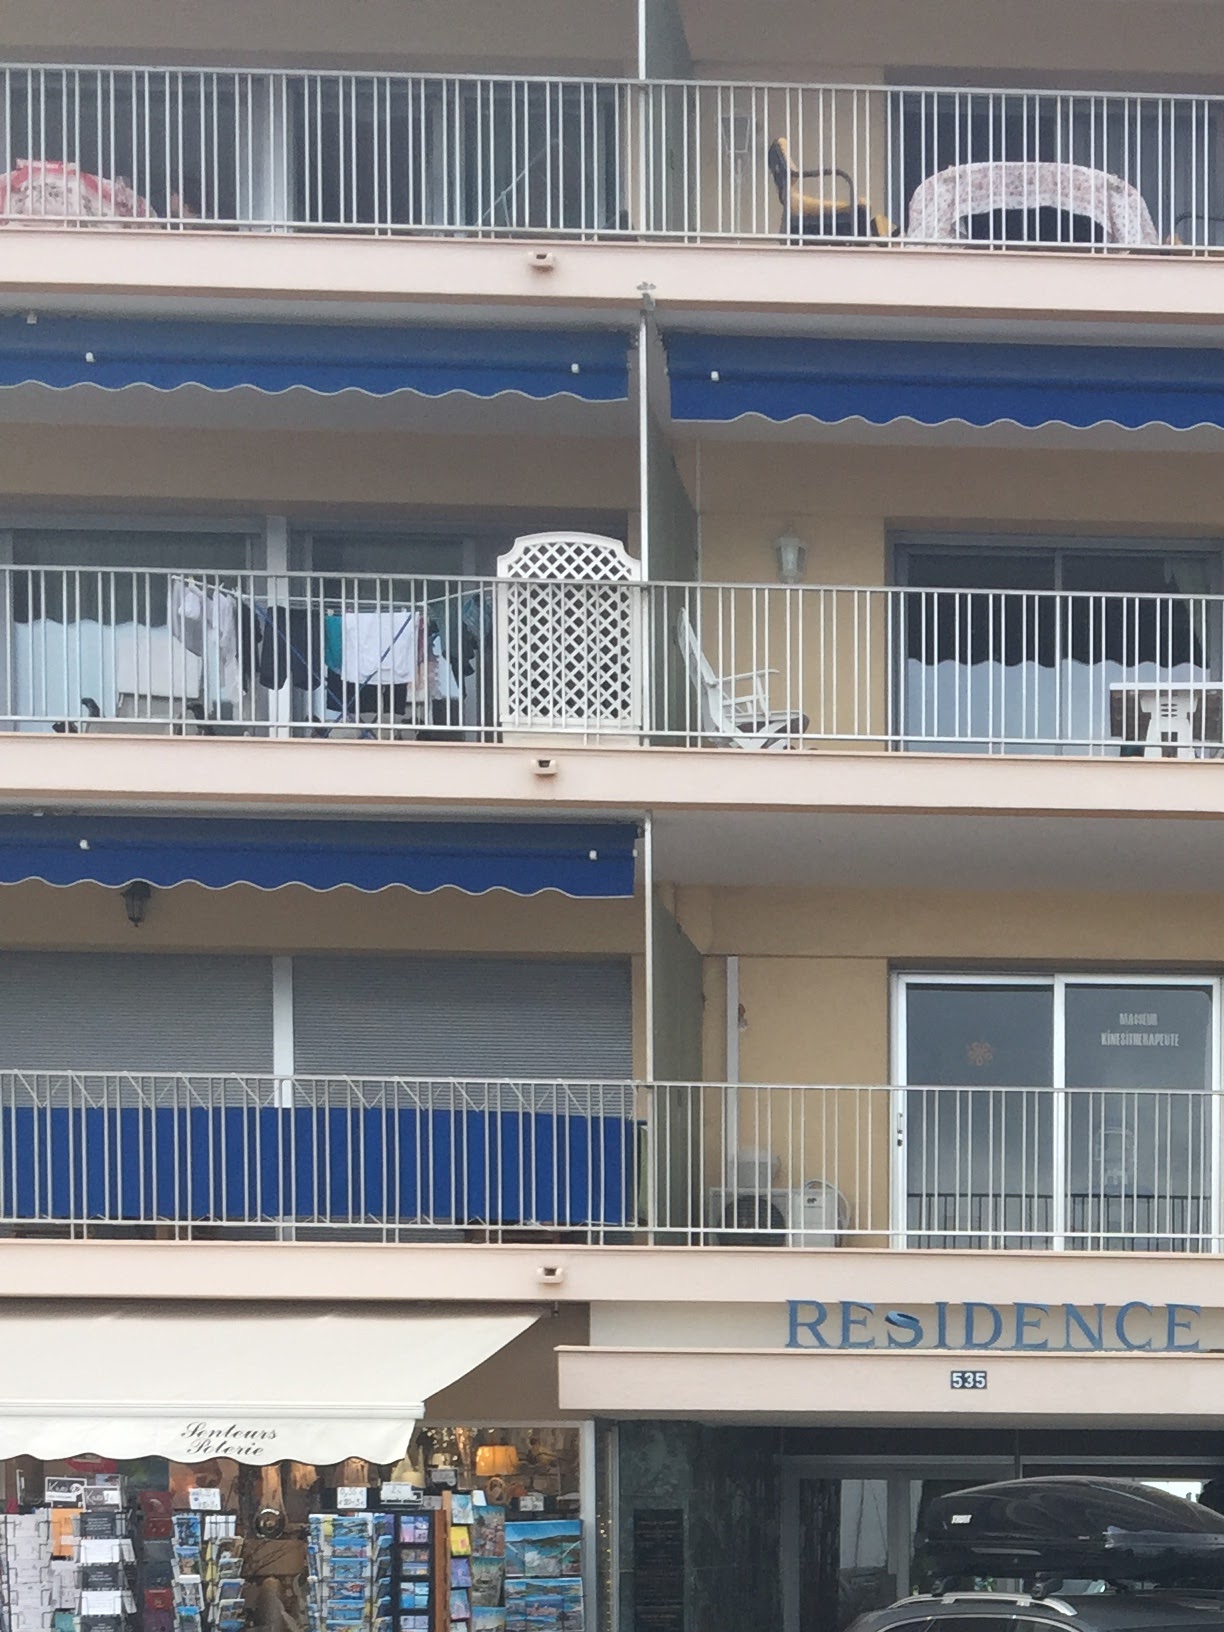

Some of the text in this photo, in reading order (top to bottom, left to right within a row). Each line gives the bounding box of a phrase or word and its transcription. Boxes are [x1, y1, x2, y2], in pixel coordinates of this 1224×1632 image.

[786, 1300, 1201, 1351] RESIDENCE
[952, 1371, 987, 1389] 535
[181, 1421, 277, 1440] Senteurs
[187, 1438, 263, 1455] Poterie
